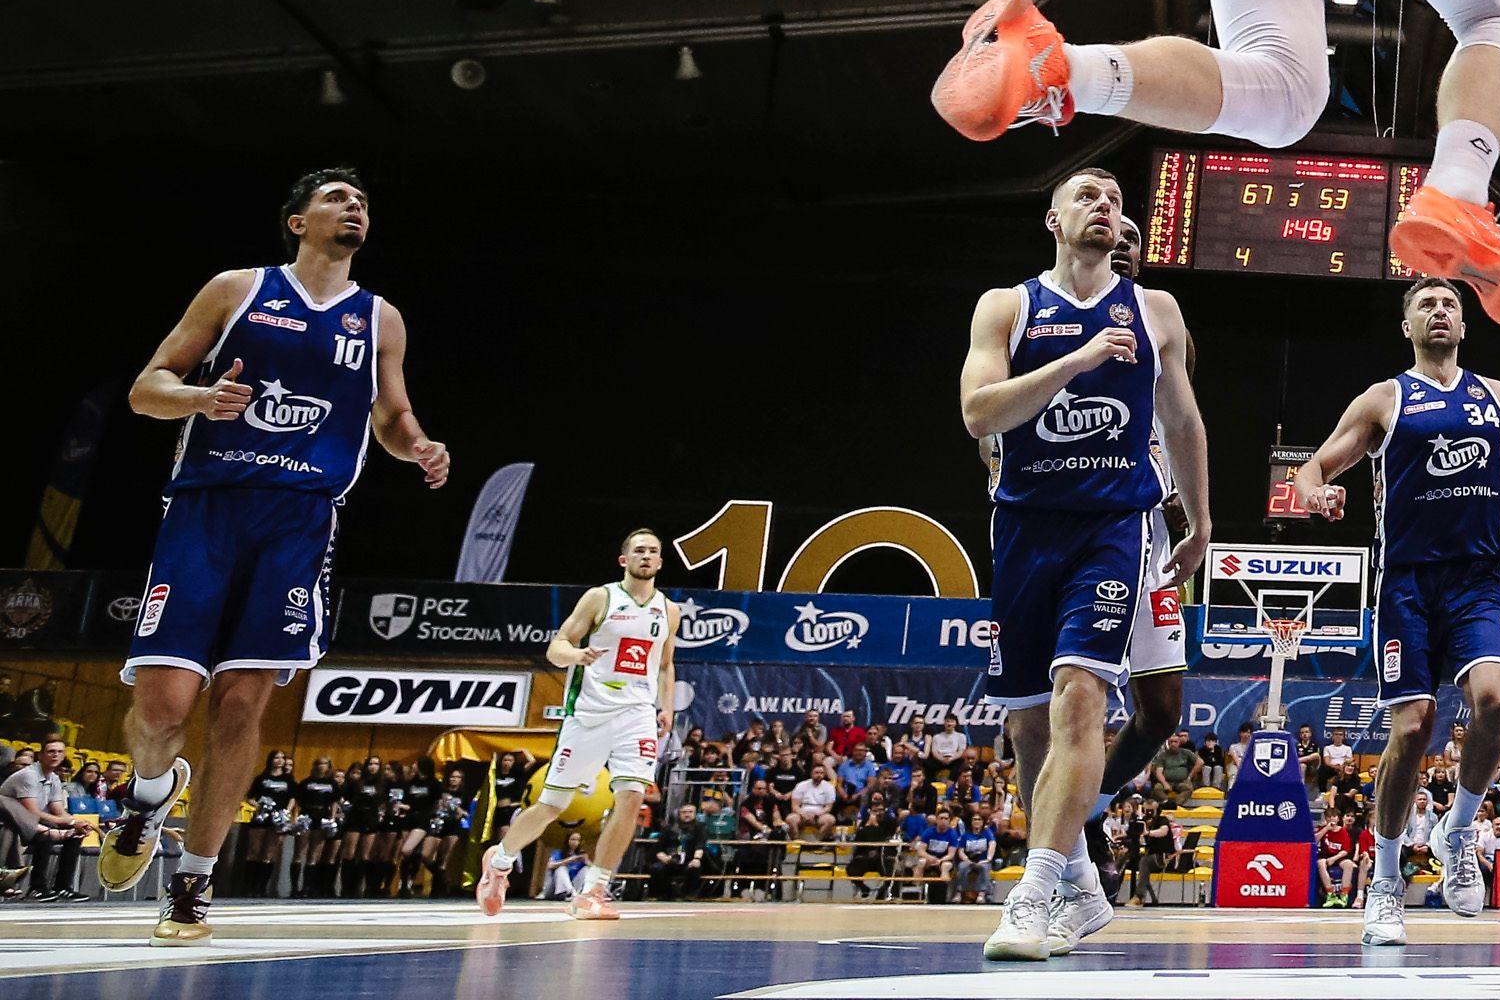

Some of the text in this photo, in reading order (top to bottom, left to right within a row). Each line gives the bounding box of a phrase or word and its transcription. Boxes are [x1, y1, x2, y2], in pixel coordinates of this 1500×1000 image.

[1242, 183, 1274, 205] 67
[1288, 191, 1300, 207] 3
[1319, 188, 1349, 210] 53
[1235, 247, 1251, 267] 4
[1329, 251, 1345, 273] 5
[263, 299, 290, 311] 4F
[1035, 305, 1059, 319] 4F
[1029, 327, 1052, 336] ORLEN
[332, 334, 365, 371] 10
[1408, 391, 1426, 401] 4F
[264, 400, 321, 425] LOTTO
[1054, 405, 1113, 432] LOTTO
[1462, 403, 1500, 428] 34
[1065, 456, 1130, 469] GDYNIA
[1271, 451, 1314, 459] AEROWATC
[1438, 444, 1479, 469] LOTTO
[1453, 486, 1491, 497] GDYNIA
[1247, 559, 1342, 576] SUZUKI
[421, 598, 470, 617] PGZ
[1093, 604, 1127, 615] WALDER
[283, 623, 307, 636] 4F
[650, 622, 660, 637] 0
[681, 616, 732, 640] LOTTO
[802, 618, 854, 643] LOTTO
[1092, 618, 1123, 632] 4F
[315, 676, 518, 716] GDYNIA
[782, 697, 844, 713] KLIMA
[1237, 801, 1275, 819] plus
[1240, 885, 1286, 897] ORLEN
